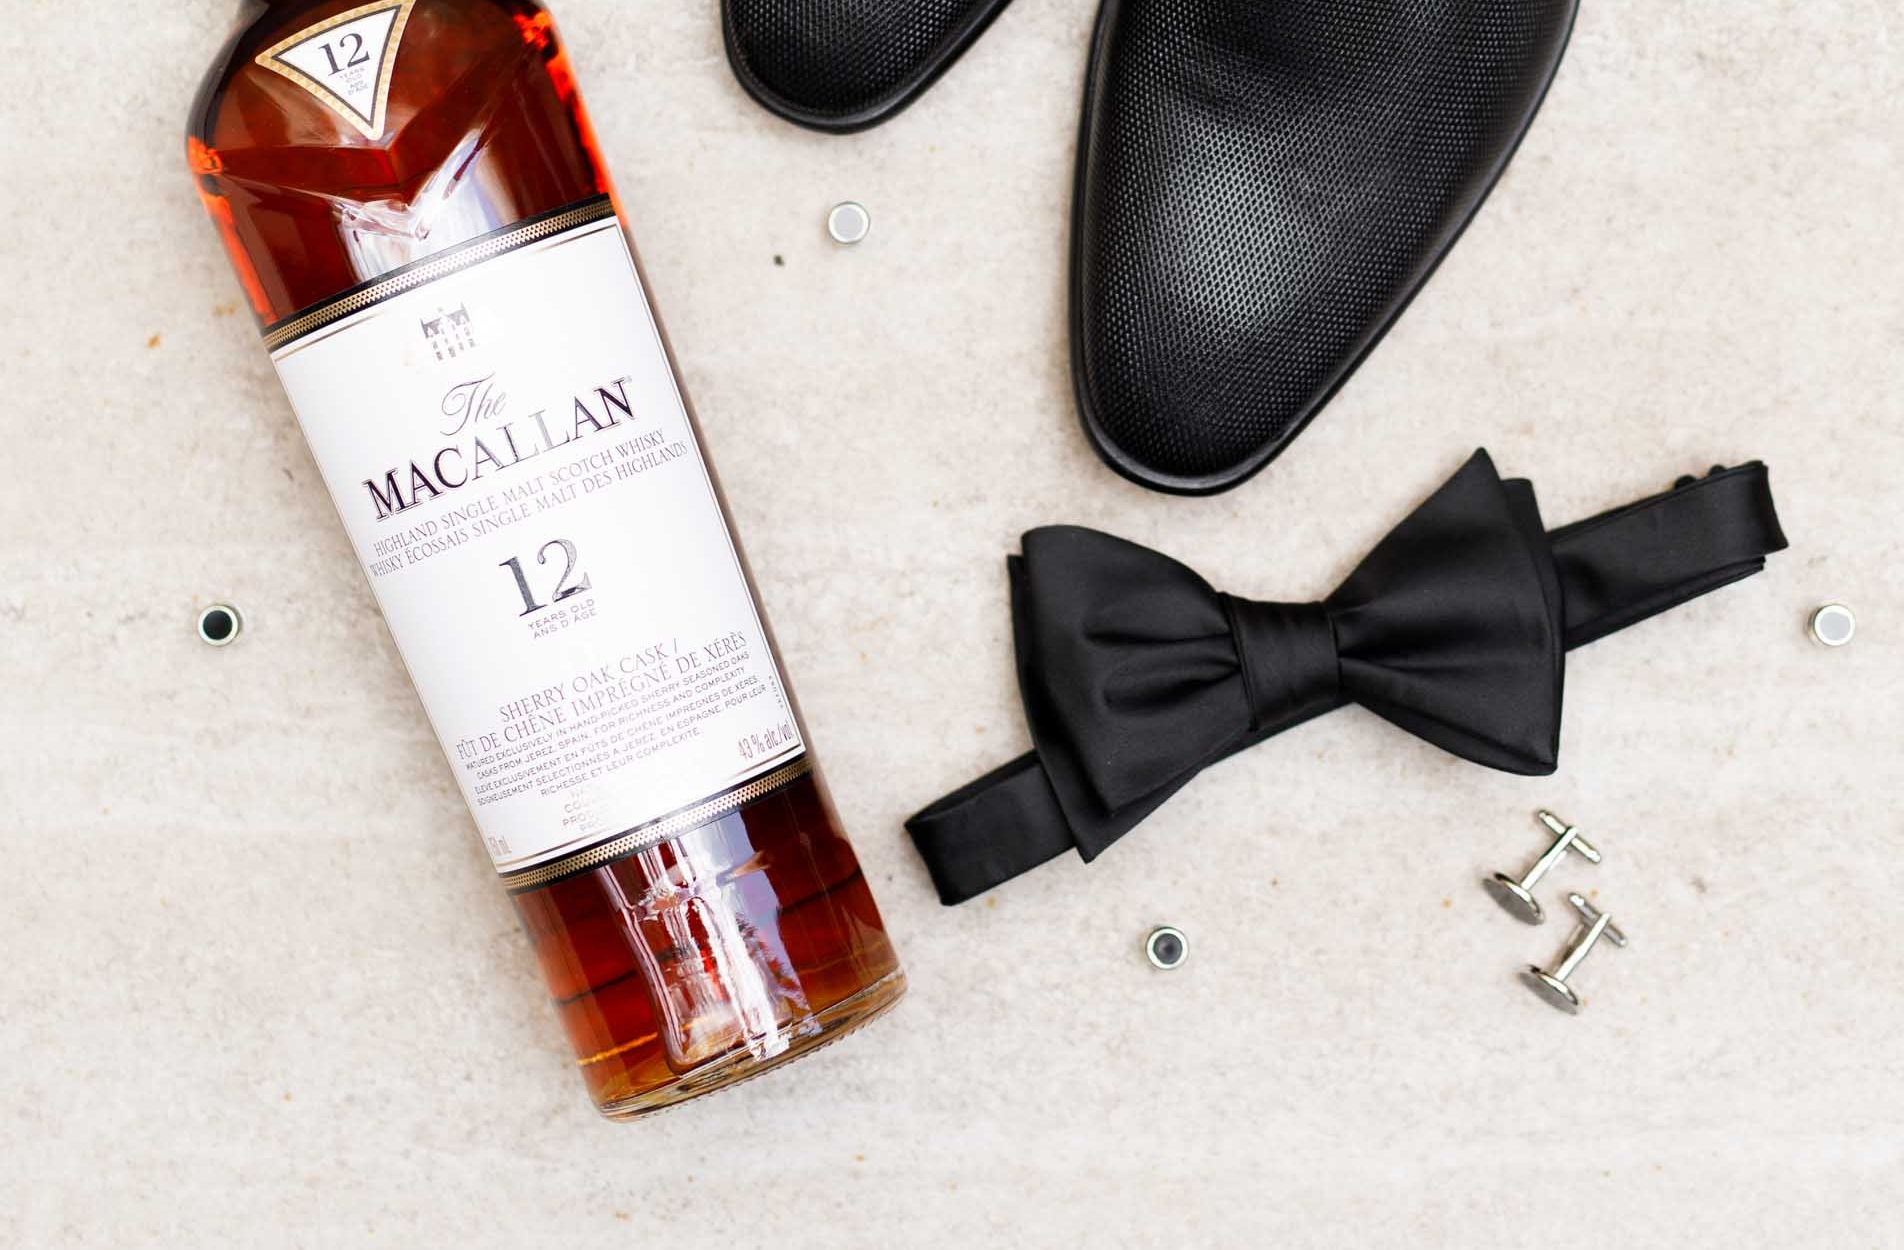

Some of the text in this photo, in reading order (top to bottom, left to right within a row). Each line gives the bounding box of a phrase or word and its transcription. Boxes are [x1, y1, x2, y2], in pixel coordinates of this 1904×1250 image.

[318, 33, 370, 76] 12
[440, 372, 506, 436] The
[362, 377, 636, 521] MACALLAN
[369, 440, 688, 577] WHISKY ÉCOSSAIS SINGLE MALT DES HIGHLANDS
[373, 428, 665, 557] HIGHLAND SINGLE MALT SCOTCH WHISKY
[499, 539, 593, 617] 12
[528, 598, 594, 630] YEARS OLD
[534, 624, 557, 638] ANS
[480, 732, 502, 752] DE
[504, 707, 567, 742] CHÊNE
[572, 662, 671, 716] IMPRÉGNÉ
[676, 651, 701, 674] DE
[703, 630, 747, 662] XÉRÈS
[496, 732, 553, 761] EXCLUSIVELY
[556, 727, 567, 736] IN
[641, 681, 679, 703] SHERRY
[682, 660, 730, 685] SEASONED
[731, 651, 750, 665] OAKS
[499, 682, 564, 722] SHERRY
[572, 665, 615, 692] OAK
[620, 642, 668, 673] CASK
[660, 726, 675, 737] EN
[725, 692, 748, 708] POUR
[749, 684, 766, 699] LEUR
[477, 766, 498, 779] CASKS
[499, 758, 521, 770] FROM
[594, 721, 615, 734] FOR
[618, 699, 671, 724] RICHNESS
[673, 690, 693, 702] AND
[695, 666, 745, 693] COMPLEXITY
[494, 757, 561, 788] EXCLUSIVEMENT
[564, 751, 578, 762] EN
[610, 732, 624, 743] DE
[722, 685, 734, 697] DE
[738, 738, 753, 759] 43
[751, 734, 765, 753] %
[540, 772, 589, 796] RICHESSE
[590, 767, 602, 778] ET
[606, 755, 633, 771] LEUR
